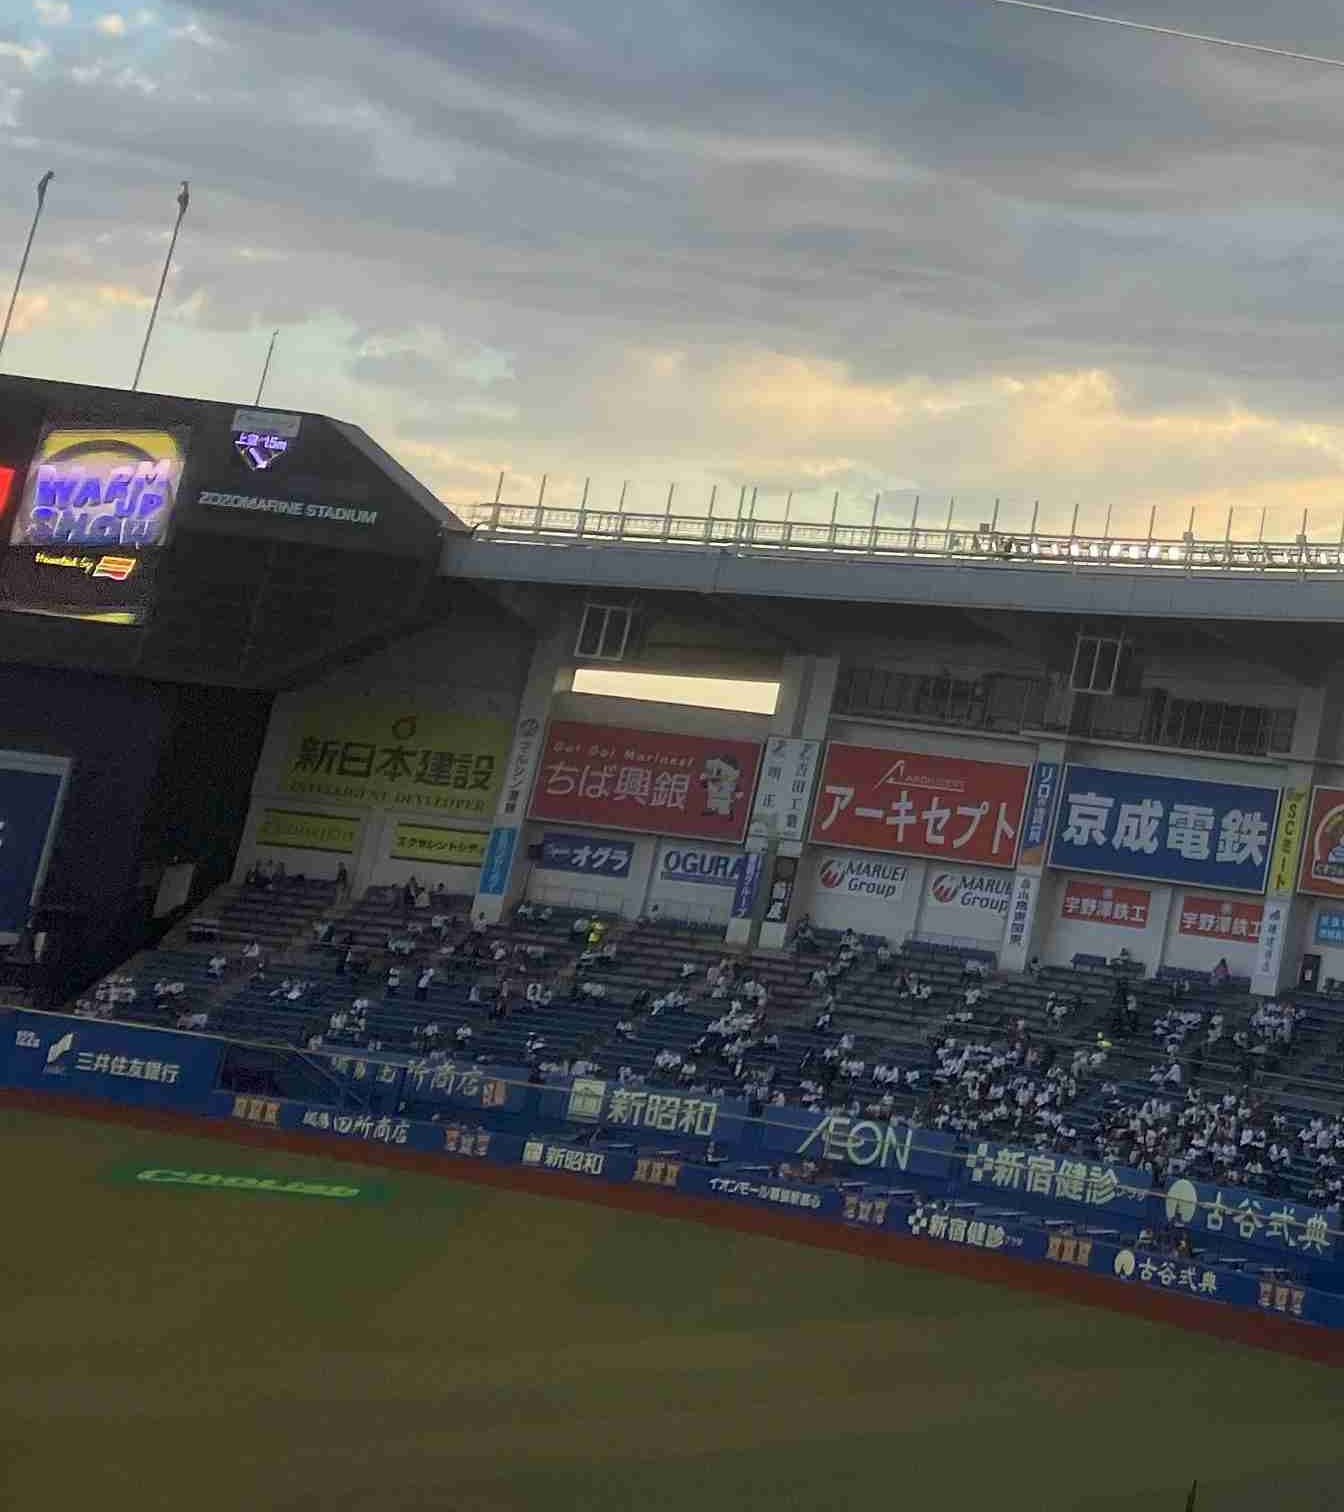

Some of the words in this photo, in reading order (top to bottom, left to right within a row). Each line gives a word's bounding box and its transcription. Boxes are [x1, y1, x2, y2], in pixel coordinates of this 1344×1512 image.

[304, 502, 378, 527] STADIUM
[291, 736, 496, 791] 新日本建設
[545, 761, 691, 811] ちば興銀
[820, 784, 1016, 856] アーキセプト
[1061, 791, 1269, 868] 京成電鉄
[848, 878, 897, 899] Group
[76, 1050, 181, 1085] 三井住友銀行
[607, 1088, 718, 1137] 新昭和
[543, 1145, 605, 1176] 新昭和
[1207, 1191, 1331, 1254] 古谷式典
[1138, 1256, 1217, 1296] 古谷式典
